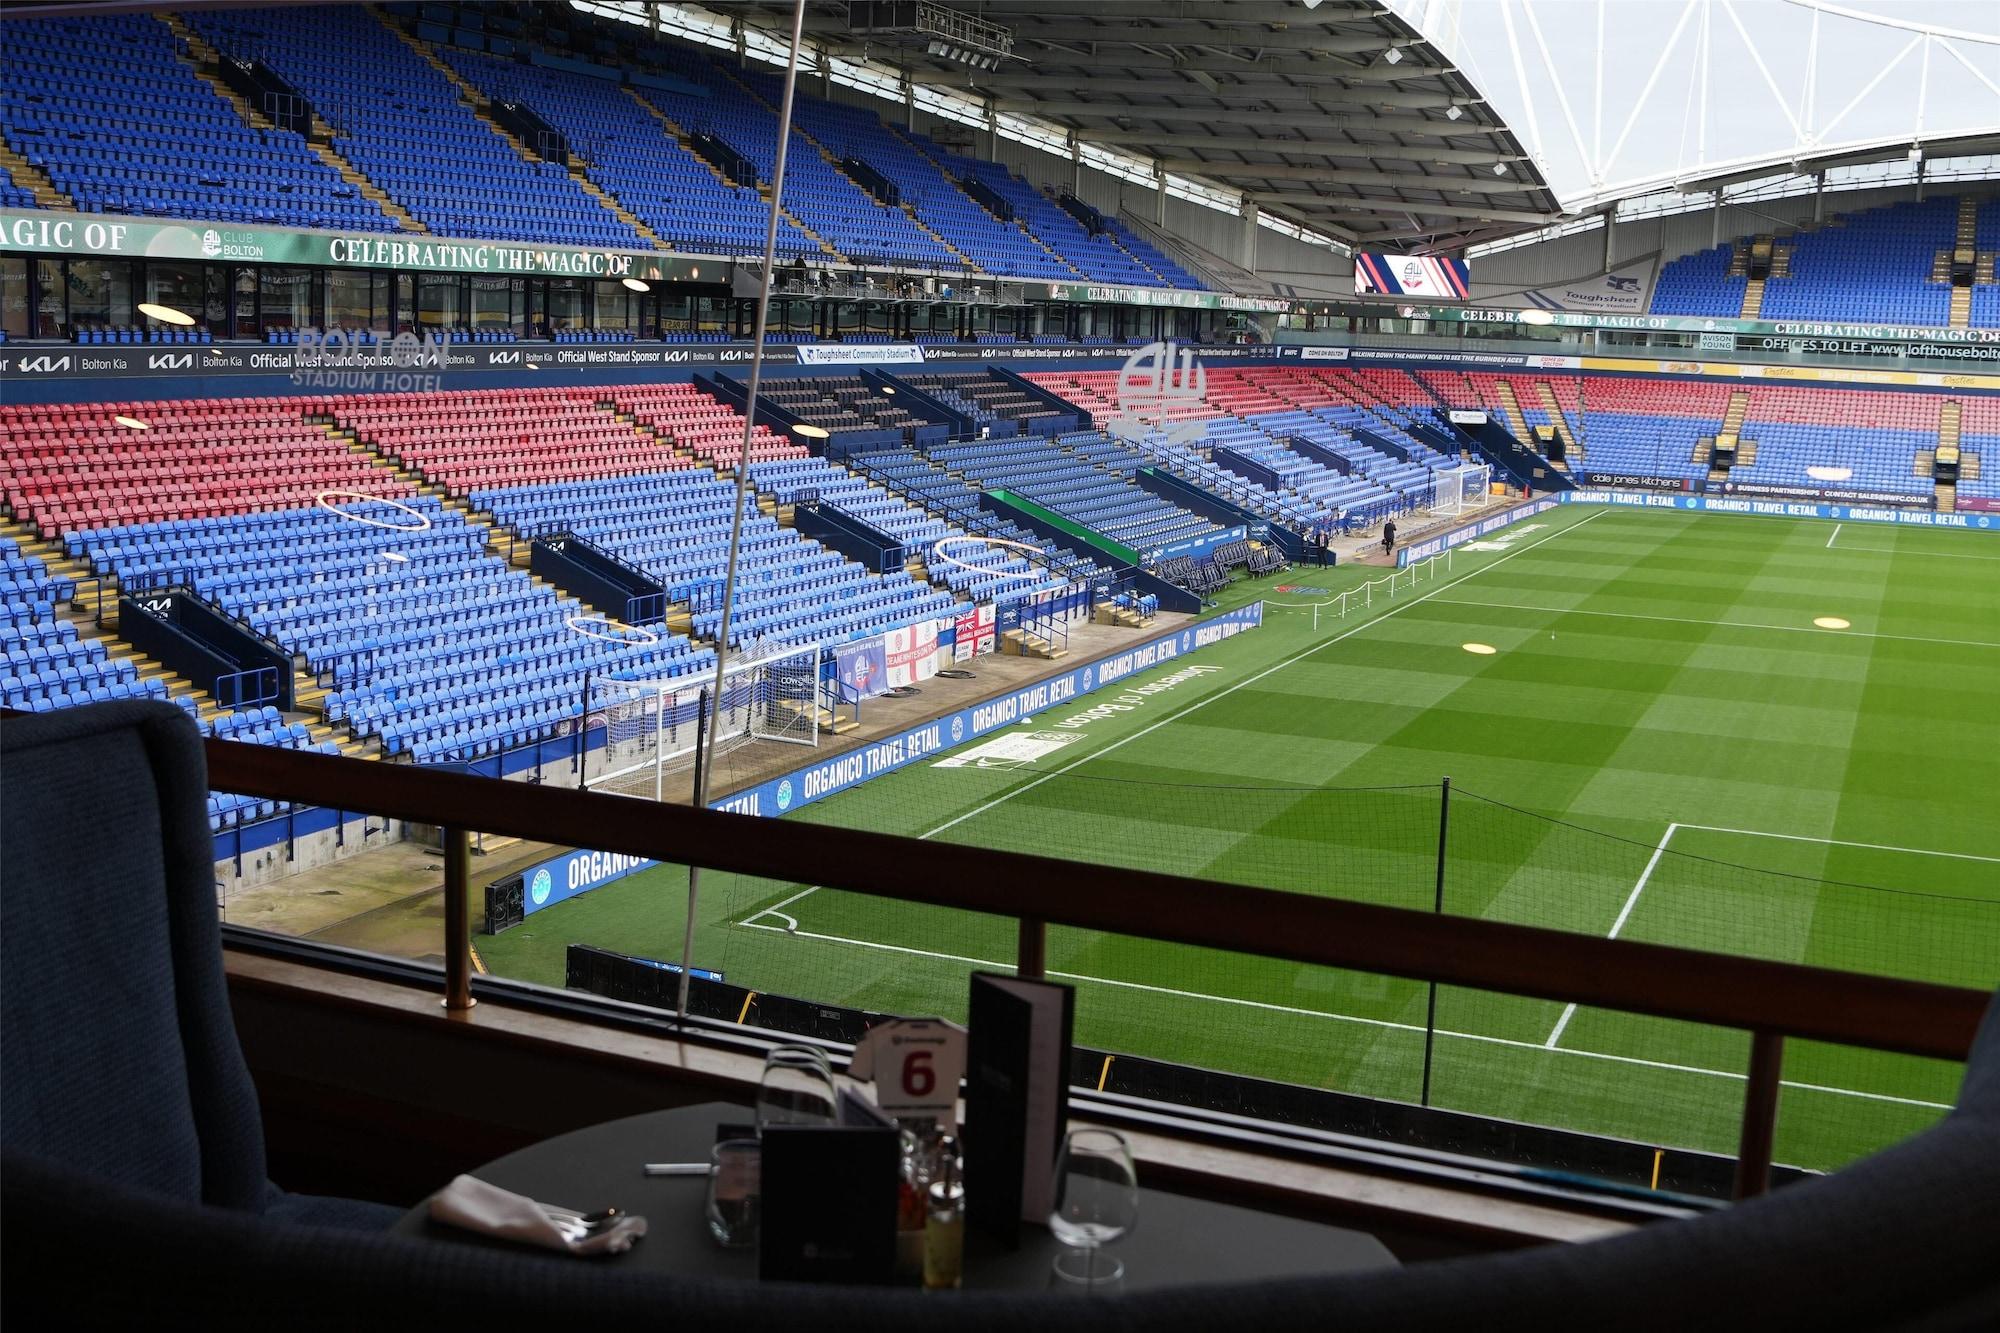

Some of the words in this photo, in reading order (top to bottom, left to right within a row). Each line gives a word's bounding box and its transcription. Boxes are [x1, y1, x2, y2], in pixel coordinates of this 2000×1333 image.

[84, 223, 127, 250] OF
[223, 231, 254, 244] CLUB
[223, 244, 264, 257] BOLTON
[329, 238, 488, 268] CELEBRATING
[495, 249, 535, 270] THE
[542, 251, 604, 274] MAGIC
[609, 254, 633, 275] OF
[1087, 286, 1136, 301] CELEBRATING
[1137, 290, 1150, 302] THE
[1151, 291, 1173, 304] MAGIC
[1565, 290, 1638, 304] Toughsheet
[1563, 298, 1603, 308] Community
[1460, 310, 1558, 325] CELEBRAG
[1564, 315, 1590, 327] THE
[1592, 316, 1645, 328] MAGIC
[1649, 318, 1669, 328] OF
[1774, 323, 1882, 338] CELEBRATING
[1888, 327, 1918, 339] THE
[1923, 329, 1977, 342] MAGIC
[1981, 331, 2000, 343] OF
[297, 327, 451, 369] BOLTON
[1702, 341, 1731, 349] YOUNG
[1762, 337, 1816, 351] OFFICES
[1820, 339, 1838, 352] TO
[1843, 341, 1867, 353] LET
[250, 353, 291, 368] Official
[294, 353, 322, 368] West
[446, 354, 465, 364] Bolton
[465, 354, 475, 364] Kia
[489, 351, 519, 364] KIA
[526, 353, 543, 362] Bolton
[544, 353, 553, 362] Kia
[557, 350, 586, 363] Official
[587, 350, 608, 363] West
[608, 350, 631, 363] Stand
[631, 351, 660, 364] Sponsor
[664, 350, 688, 362] KIA
[693, 353, 707, 361] Bolton
[707, 353, 715, 361] Kia
[720, 350, 741, 361] KIA
[815, 348, 851, 361] Toughsheet
[852, 348, 886, 361] Community
[886, 347, 910, 360] Stadium
[925, 349, 940, 358] KIA
[981, 349, 996, 358] KIA
[1062, 349, 1075, 358] KIA
[1474, 355, 1506, 363] BURNDEN
[21, 356, 70, 372] KIA
[82, 358, 111, 370] Bolton
[113, 358, 127, 370] Kia
[149, 354, 192, 369] KIA
[203, 356, 228, 367] Bolton
[230, 356, 242, 367] Kia
[1761, 367, 1795, 377] Pasties
[293, 369, 379, 390] STADIUM
[382, 373, 443, 392] HOTEL
[1942, 375, 1975, 385] Pasties
[1611, 475, 1639, 486] jones
[1641, 476, 1681, 488] kitchens
[1570, 492, 1610, 503] ORGANICO
[1612, 493, 1644, 505] TRAVEL
[1646, 496, 1676, 507] RETAIL
[1737, 484, 1770, 493] BUSINESS
[1770, 486, 1820, 497] PARTNERSHIPS
[1824, 490, 1857, 499] CONTACT
[1857, 492, 1929, 504] SALES@BWFC.CO.UK
[1705, 498, 1750, 511] ORGANICO
[1753, 501, 1785, 514] TRAVEL
[1787, 504, 1818, 516] RETAIL
[1849, 508, 1896, 521] ORGANICO
[1899, 511, 1932, 524] TRAVEL
[1935, 514, 1967, 526] RETAIL
[1195, 624, 1222, 647] ORGANICO
[1099, 659, 1133, 684] ORGANICO
[1134, 647, 1157, 671] TRAVEL
[1156, 639, 1177, 661] RETAIL
[781, 673, 814, 686] cowgills
[1125, 665, 1224, 696] University
[973, 696, 1017, 734] ORGANICO
[1019, 685, 1048, 715] TRAVEL
[1050, 675, 1076, 704] RETAIL
[1113, 695, 1145, 706] of
[1053, 703, 1136, 729] Bolton
[804, 754, 863, 799] ORGANICO
[866, 739, 905, 774] TRAVEL
[907, 725, 942, 759] RETAIL
[717, 792, 761, 817] ETAIL
[568, 850, 650, 890] ORGANI
[902, 1051, 936, 1097] 6
